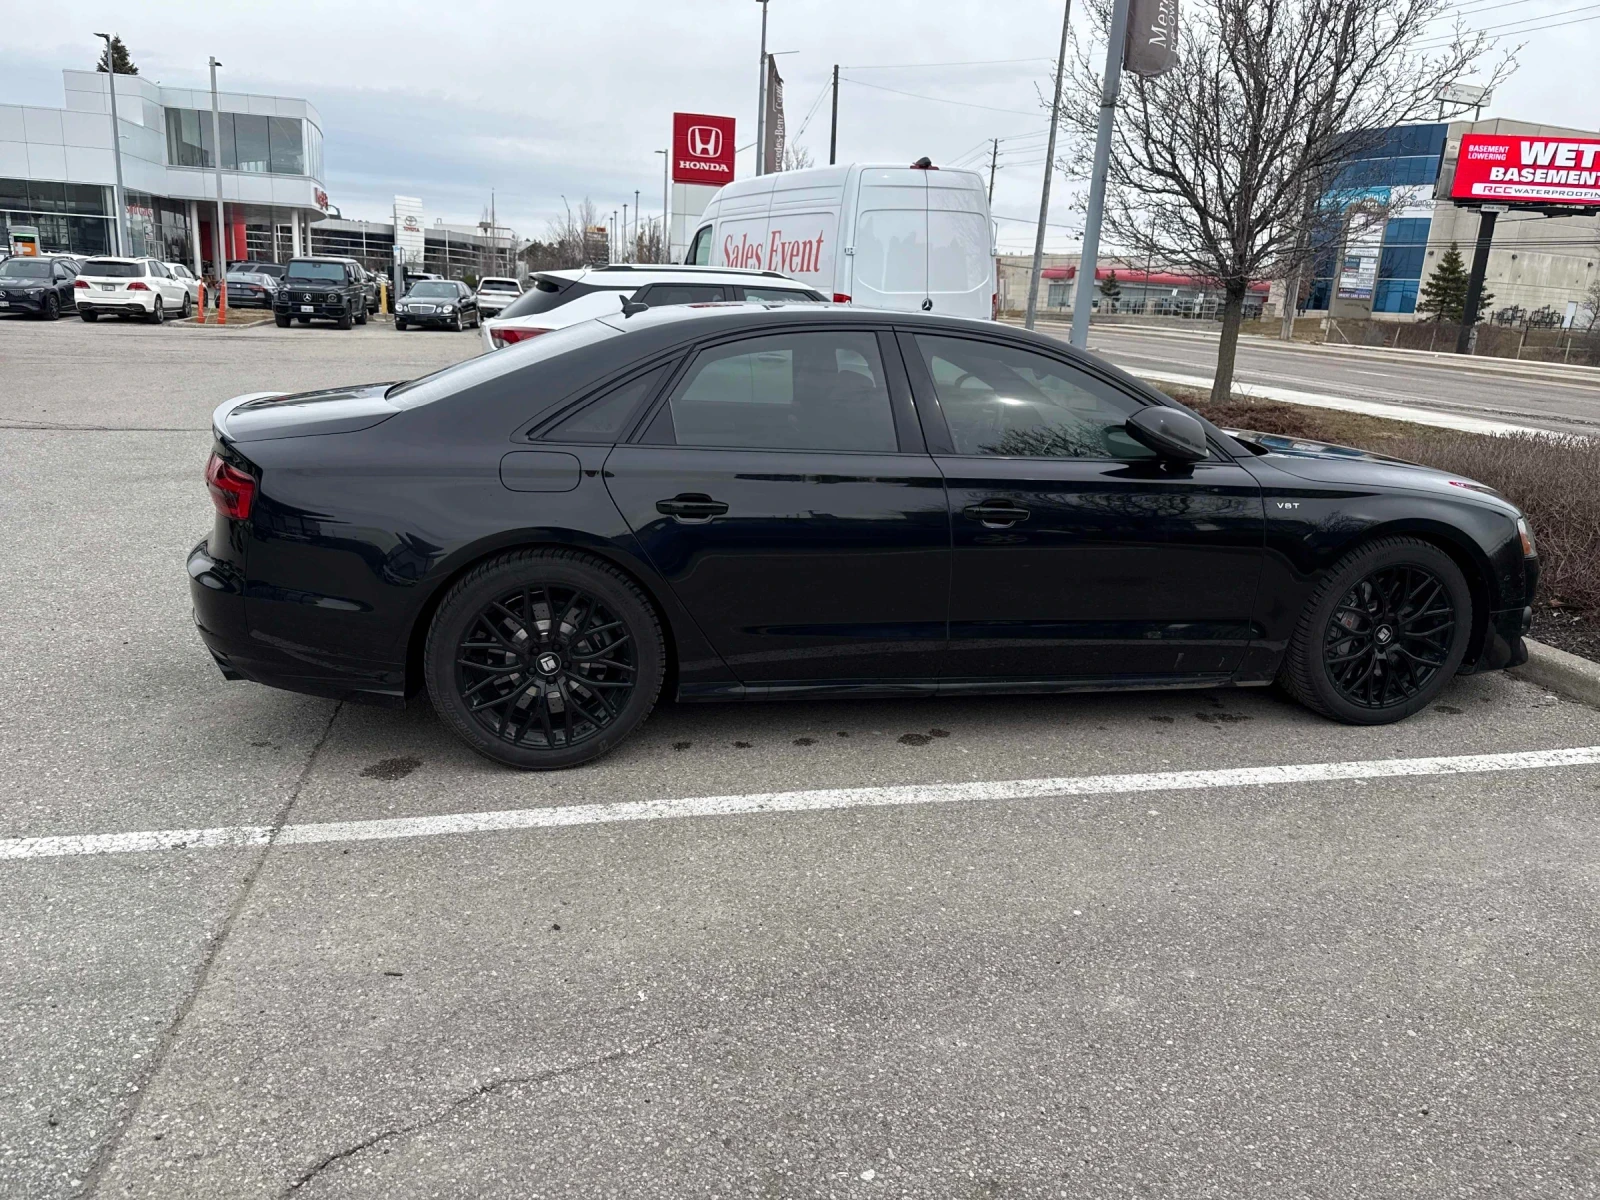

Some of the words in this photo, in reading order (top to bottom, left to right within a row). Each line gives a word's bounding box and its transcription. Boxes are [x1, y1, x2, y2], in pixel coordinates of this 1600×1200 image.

[774, 113, 785, 172] ercedes-Benz
[1468, 144, 1510, 154] BASEMENT
[1467, 153, 1507, 161] LOWERING
[1520, 141, 1600, 168] WET
[679, 160, 730, 173] HONDA
[1483, 185, 1513, 194] RCC
[724, 232, 763, 270] Sales
[767, 229, 824, 273] Event
